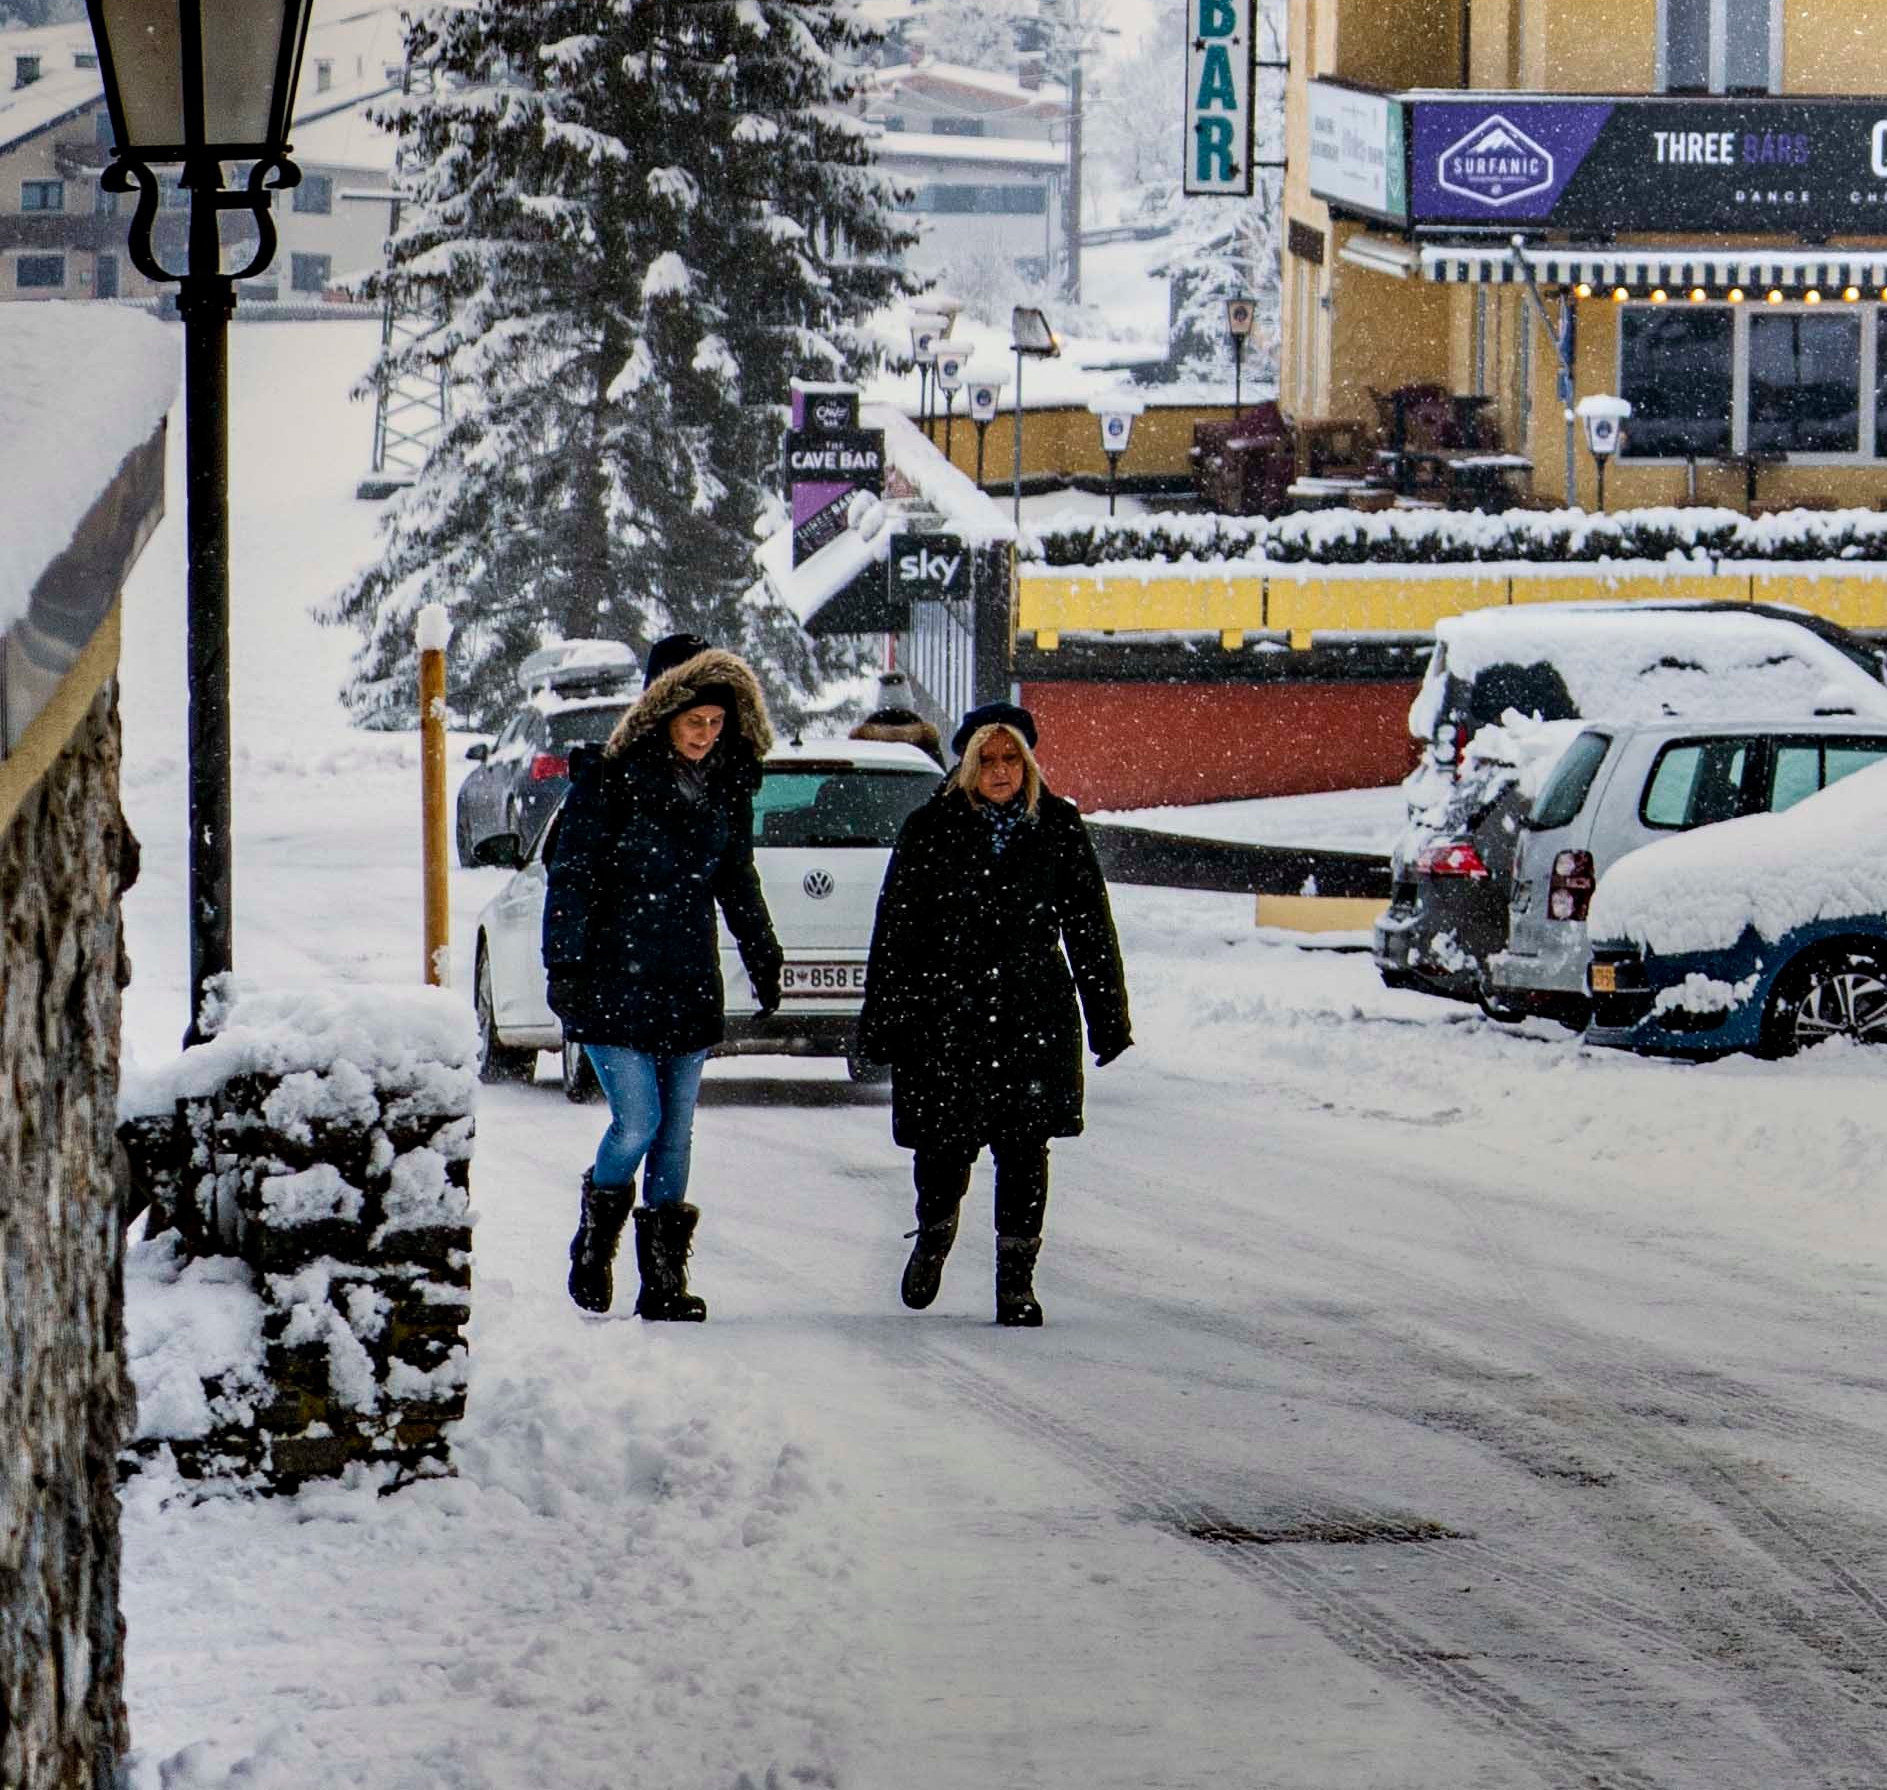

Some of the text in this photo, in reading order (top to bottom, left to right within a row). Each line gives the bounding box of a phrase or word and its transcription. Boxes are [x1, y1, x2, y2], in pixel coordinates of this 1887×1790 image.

[1653, 131, 1810, 165] THREE BARS
[1453, 157, 1540, 176] SURFANIC
[1734, 189, 1811, 204] DANCE
[791, 451, 879, 470] CAVE BAR
[899, 549, 960, 586] sky
[810, 968, 848, 988] 858
